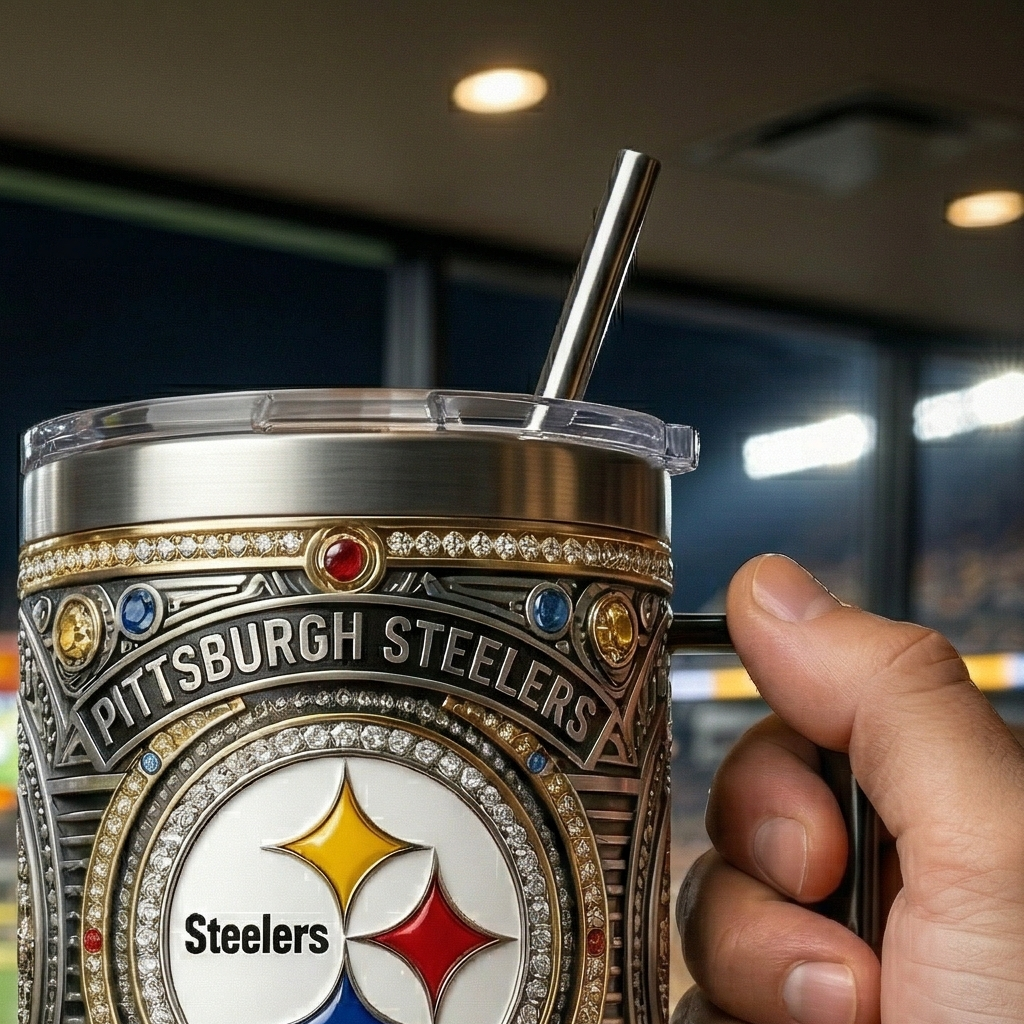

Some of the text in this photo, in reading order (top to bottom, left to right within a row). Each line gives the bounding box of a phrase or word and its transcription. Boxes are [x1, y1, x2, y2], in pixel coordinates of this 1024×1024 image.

[90, 611, 597, 747] PITTSBURGH STEELERS
[184, 912, 330, 954] Steelers
